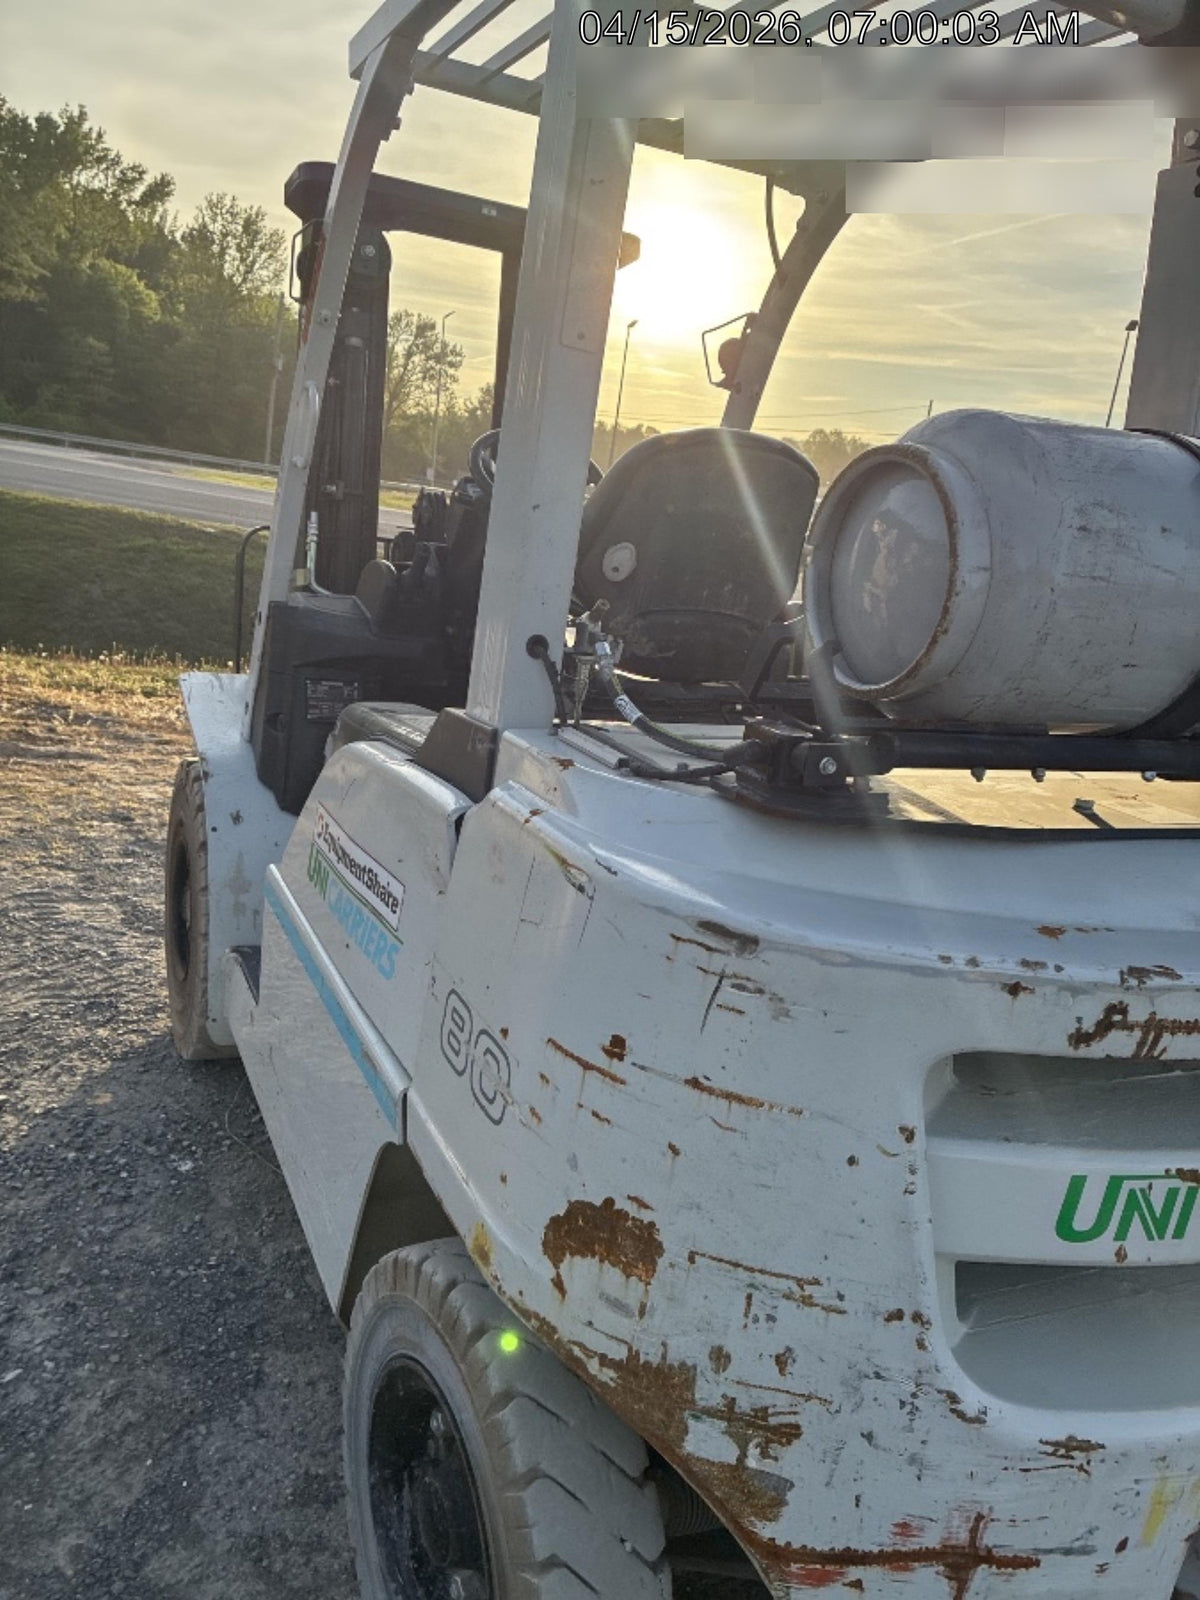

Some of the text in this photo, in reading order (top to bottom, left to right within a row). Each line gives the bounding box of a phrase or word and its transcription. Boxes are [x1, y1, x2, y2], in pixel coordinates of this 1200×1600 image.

[322, 820, 400, 915] EquipmentShare
[441, 988, 511, 1126] 80
[1055, 1174, 1200, 1243] UNI
